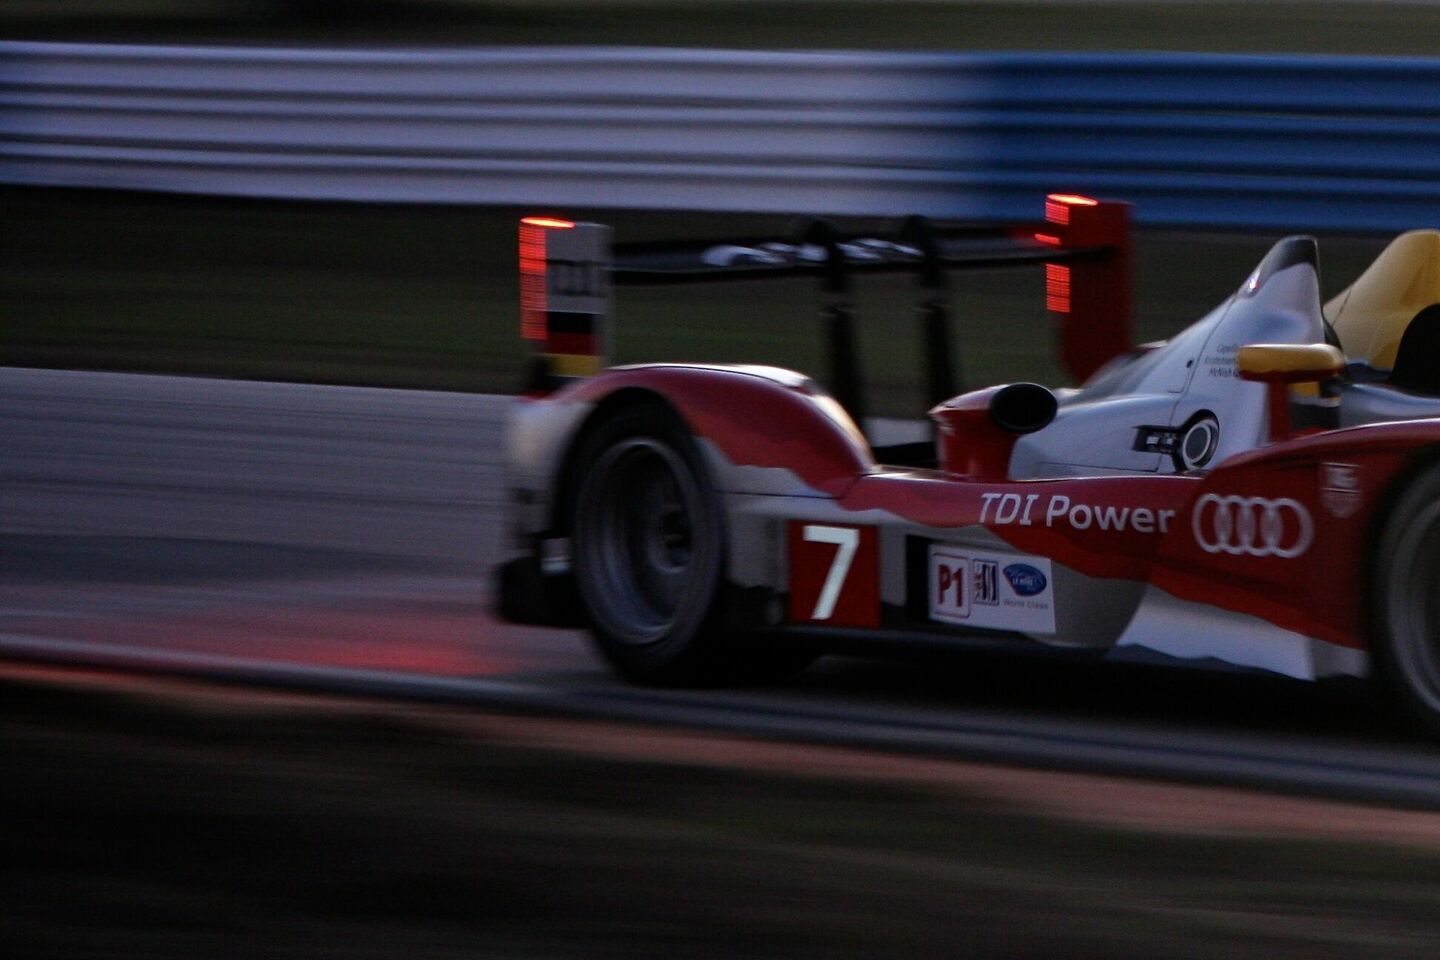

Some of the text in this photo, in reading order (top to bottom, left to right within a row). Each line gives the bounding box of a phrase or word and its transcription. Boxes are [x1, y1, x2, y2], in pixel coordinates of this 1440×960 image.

[979, 493, 1176, 534] TDI Power
[802, 524, 861, 621] 7
[938, 564, 963, 607] P1
